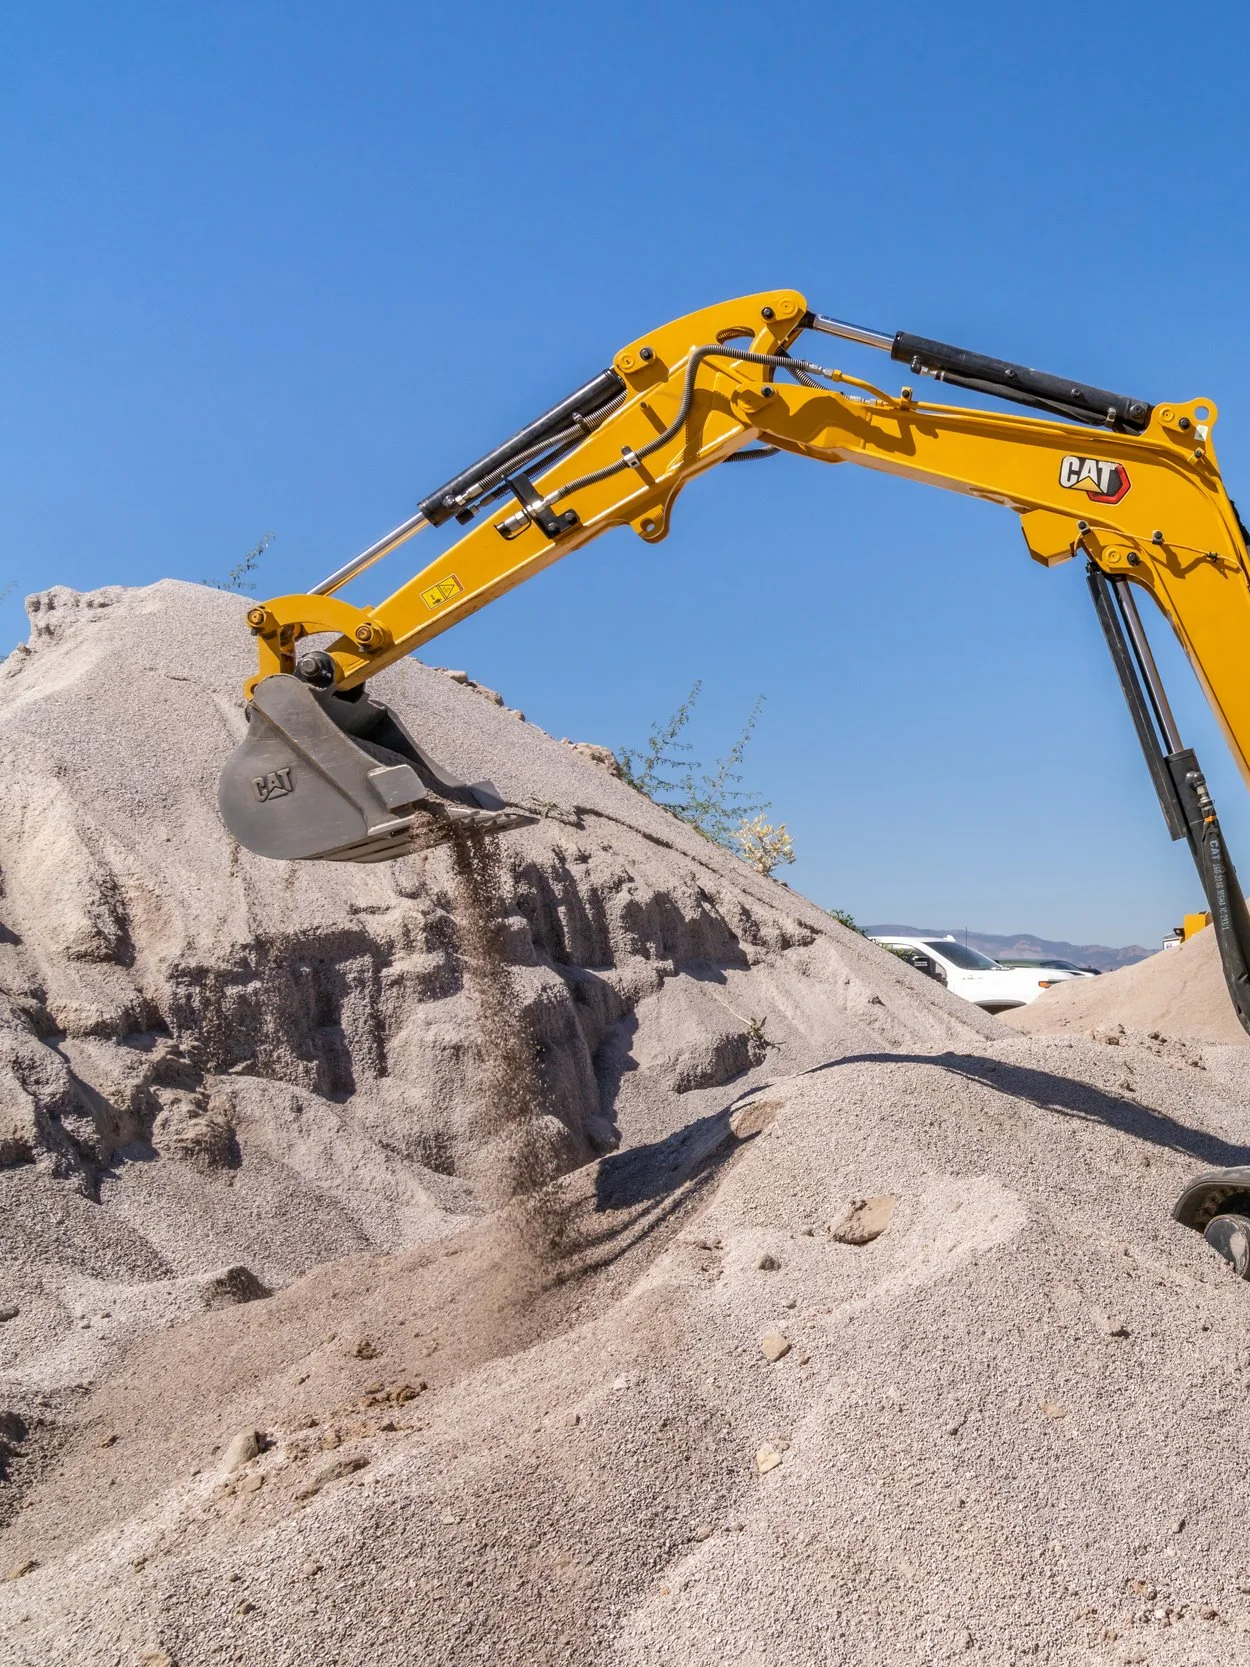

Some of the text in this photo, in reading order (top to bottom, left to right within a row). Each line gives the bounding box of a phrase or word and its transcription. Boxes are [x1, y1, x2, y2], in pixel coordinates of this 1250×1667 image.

[1060, 455, 1117, 494] CAT
[251, 768, 293, 802] CAT
[1209, 839, 1221, 861] CAT
